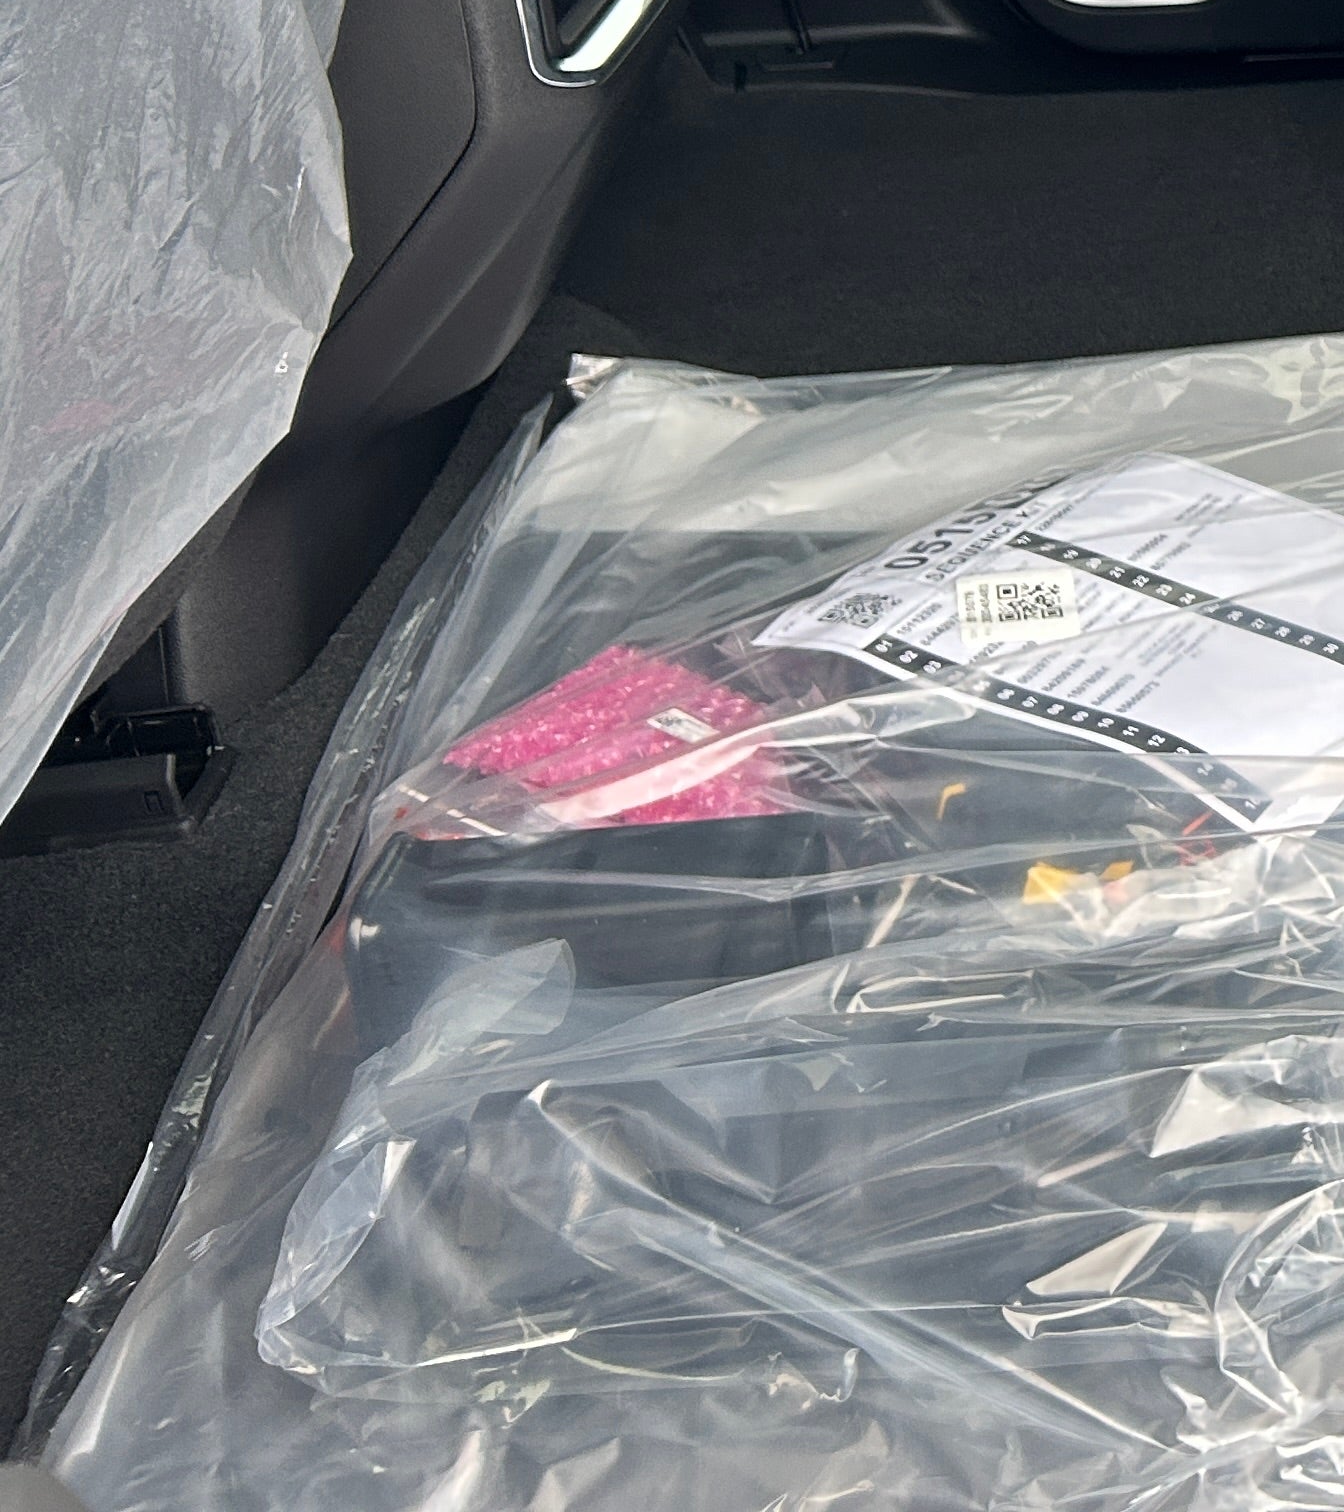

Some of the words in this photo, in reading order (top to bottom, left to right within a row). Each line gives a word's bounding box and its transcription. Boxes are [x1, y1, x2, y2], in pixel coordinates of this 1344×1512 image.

[925, 519, 1019, 582] SEQUENCE
[1109, 566, 1126, 579] 21
[1132, 574, 1150, 588] 22
[1155, 583, 1173, 597] 23
[1179, 592, 1196, 605] 24
[1250, 617, 1267, 630] 27
[899, 650, 919, 664] 02
[923, 660, 942, 674] 03
[1097, 717, 1115, 729] 10
[1122, 725, 1140, 737] 11
[1147, 734, 1166, 747] 12
